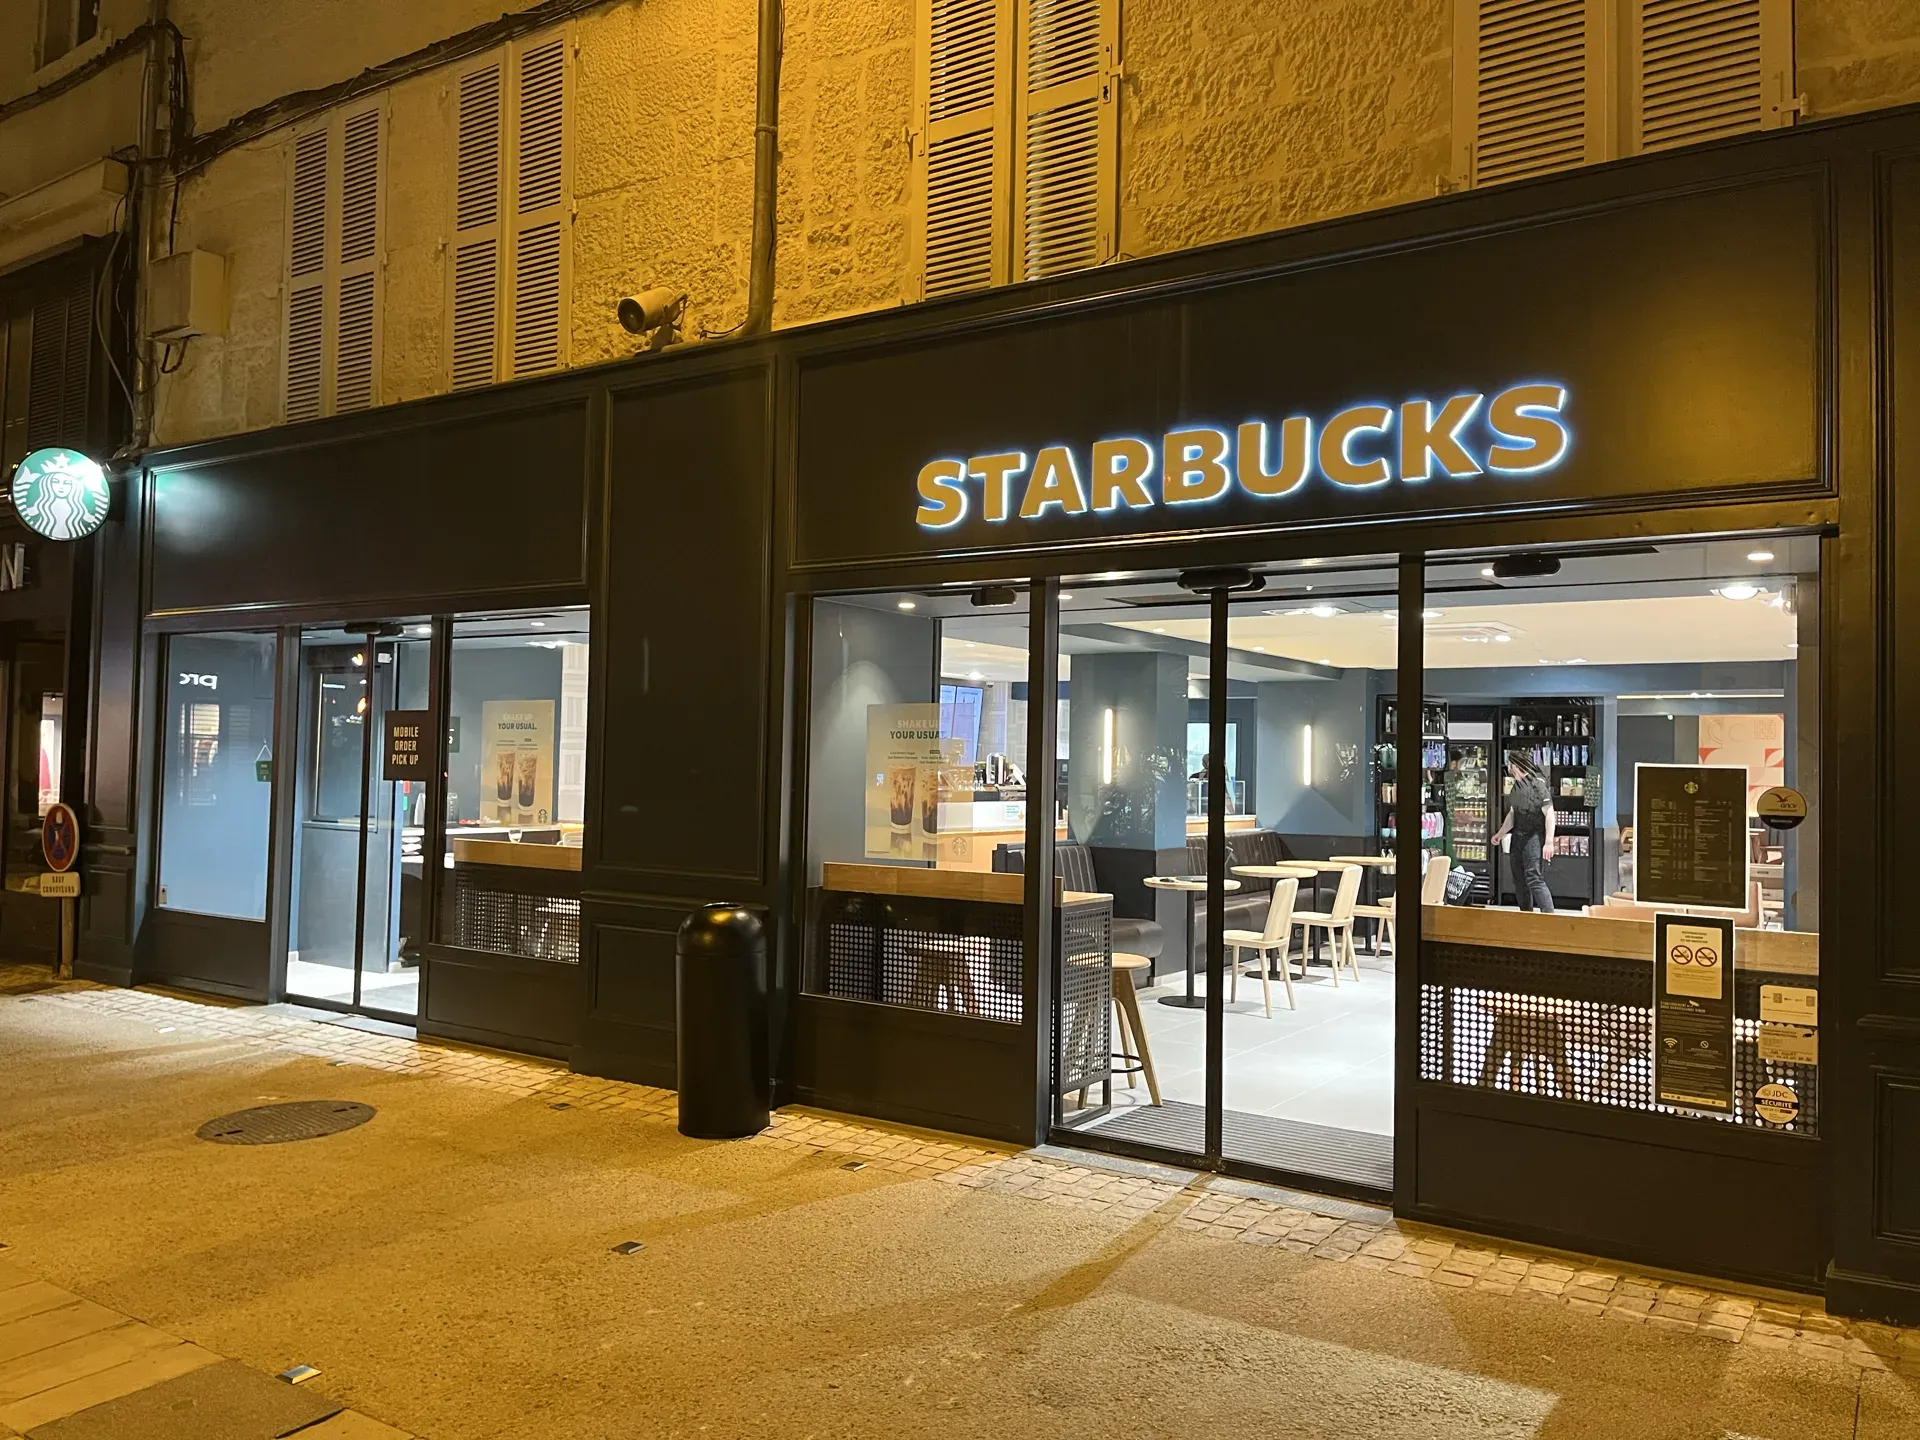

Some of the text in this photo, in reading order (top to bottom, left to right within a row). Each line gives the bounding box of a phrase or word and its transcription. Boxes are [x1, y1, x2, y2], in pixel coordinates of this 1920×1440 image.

[915, 382, 1570, 530] STARBUCKS
[498, 722, 515, 730] YOUR
[897, 719, 927, 729] SHAKE
[393, 726, 419, 738] MOBILE
[890, 731, 915, 740] YOUR
[394, 740, 417, 751] ORDER
[392, 754, 419, 766] PICK UP
[1772, 1090, 1788, 1098] JDC
